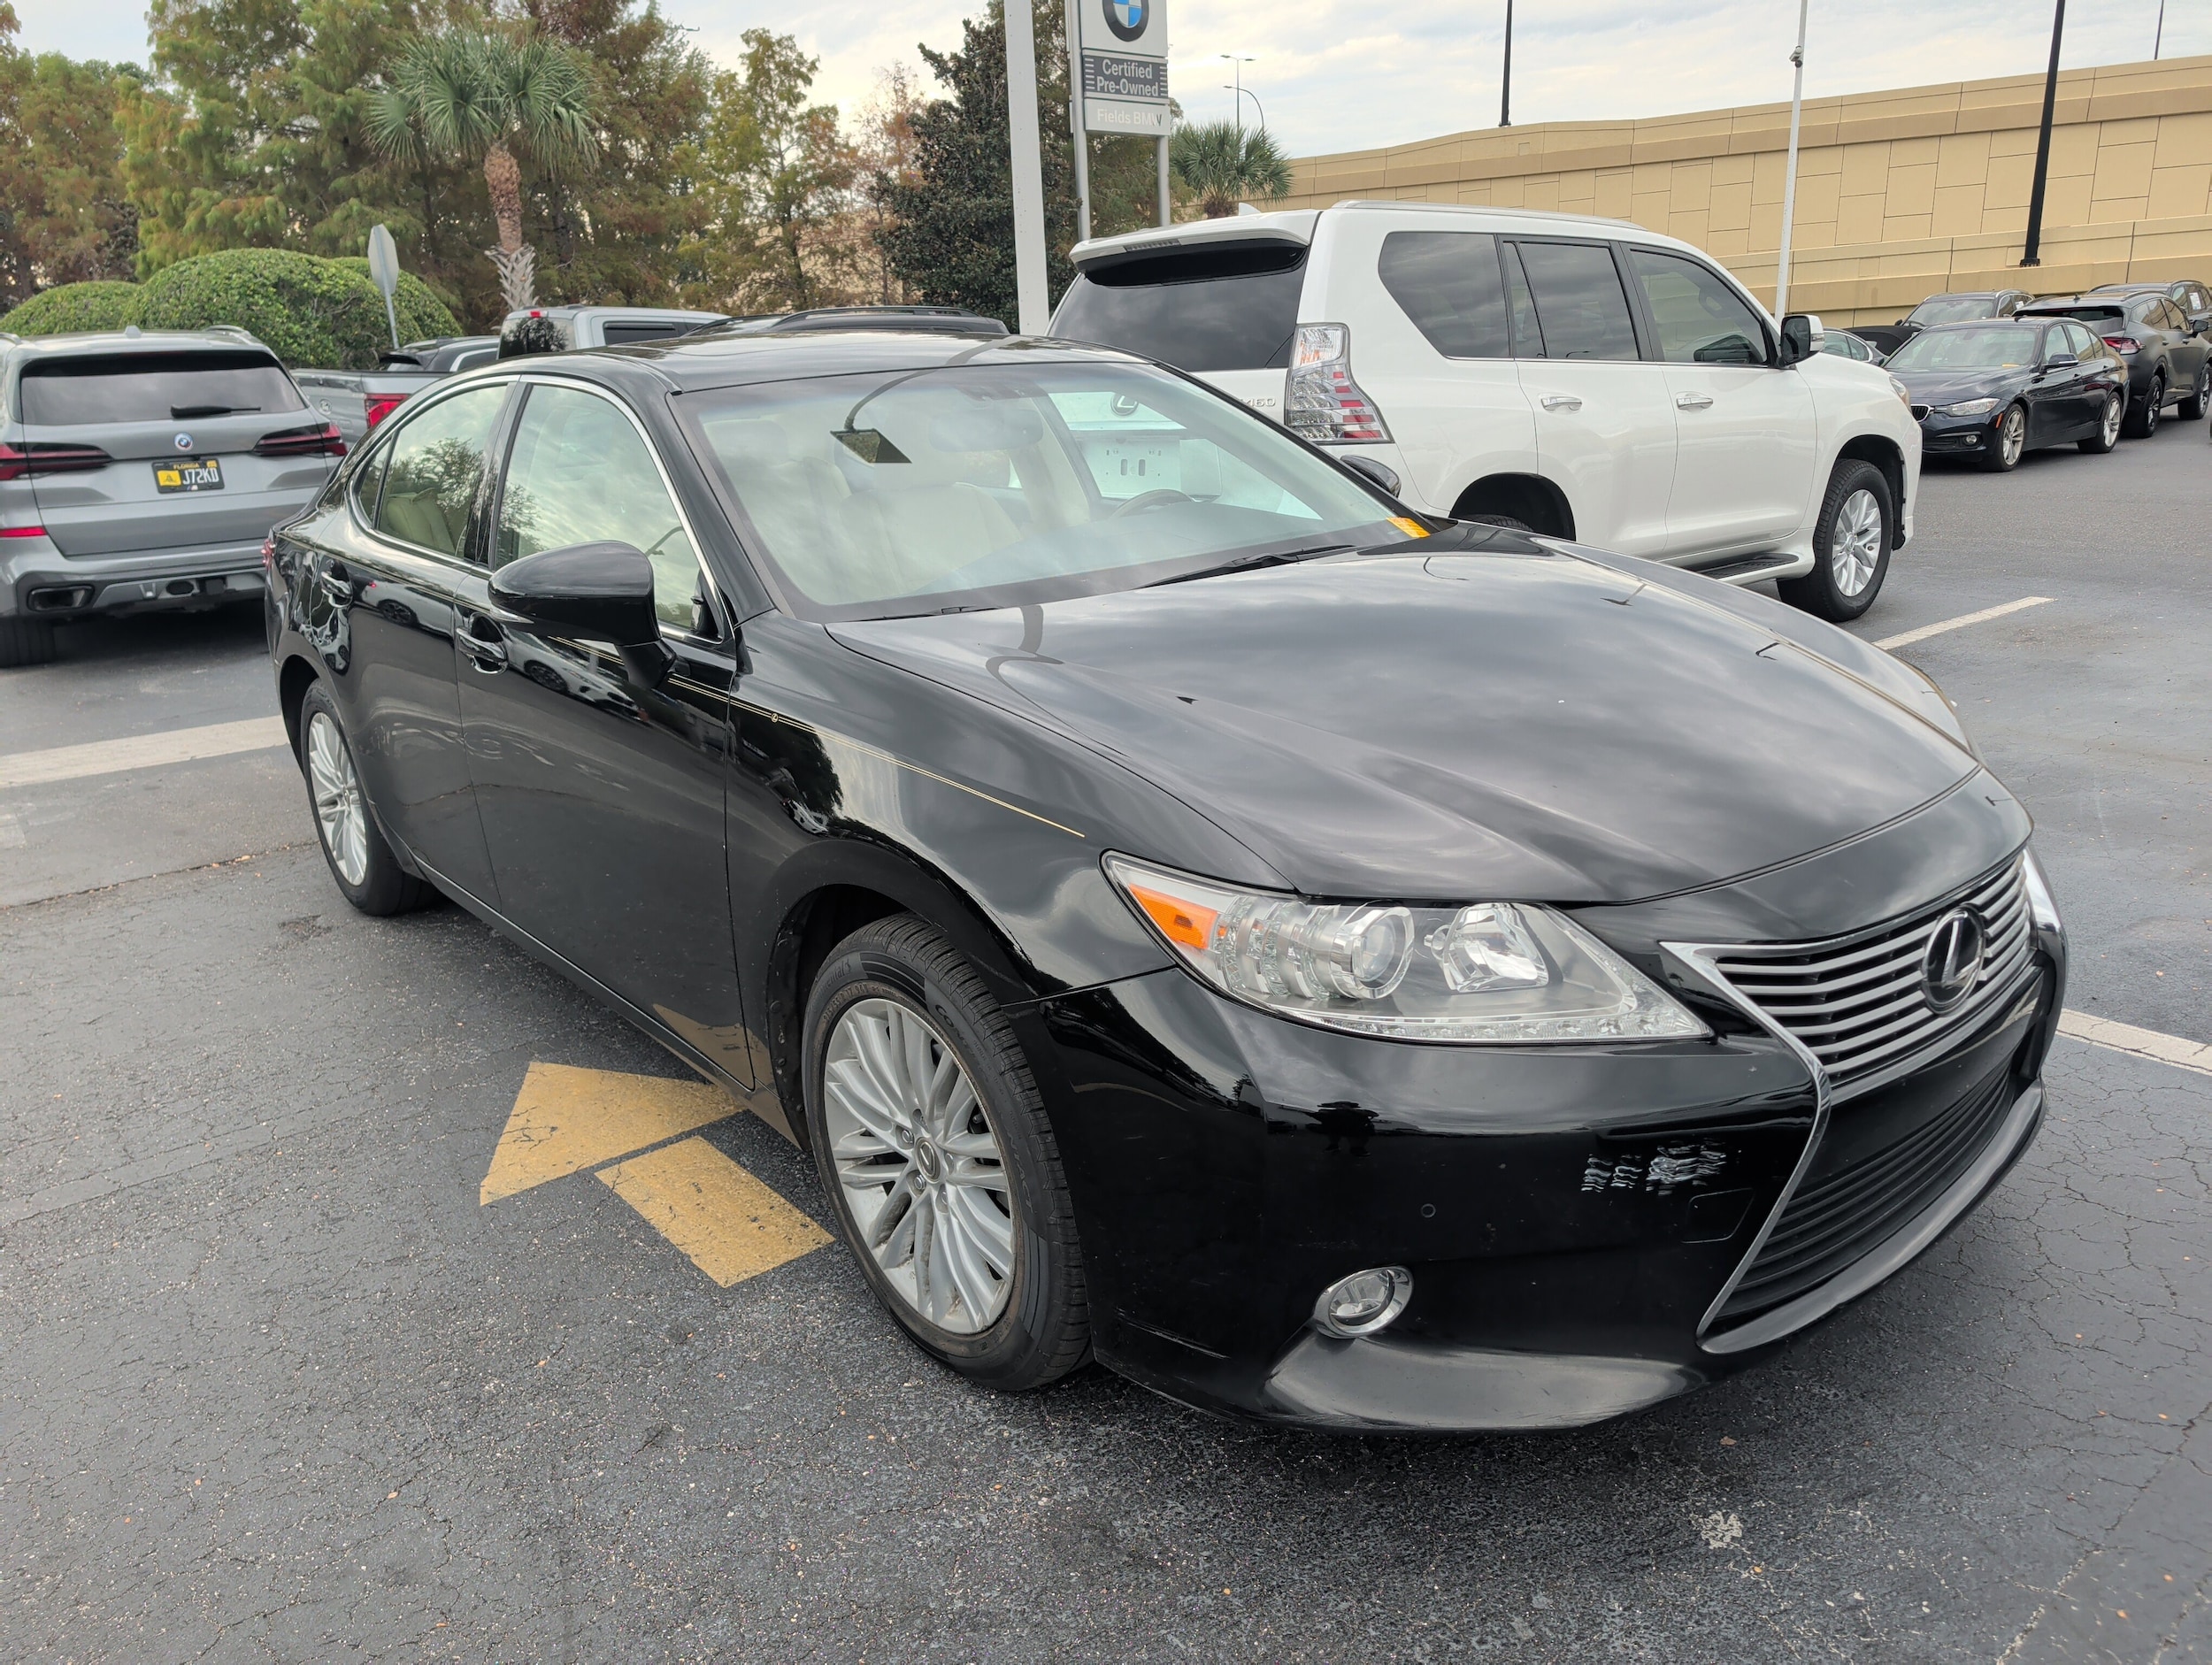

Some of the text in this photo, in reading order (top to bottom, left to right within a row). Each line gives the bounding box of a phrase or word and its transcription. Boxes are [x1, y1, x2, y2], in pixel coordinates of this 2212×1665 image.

[1102, 58, 1153, 80] Certified
[1096, 76, 1159, 97] Pre-Owned
[1097, 108, 1163, 127] Fields BMW
